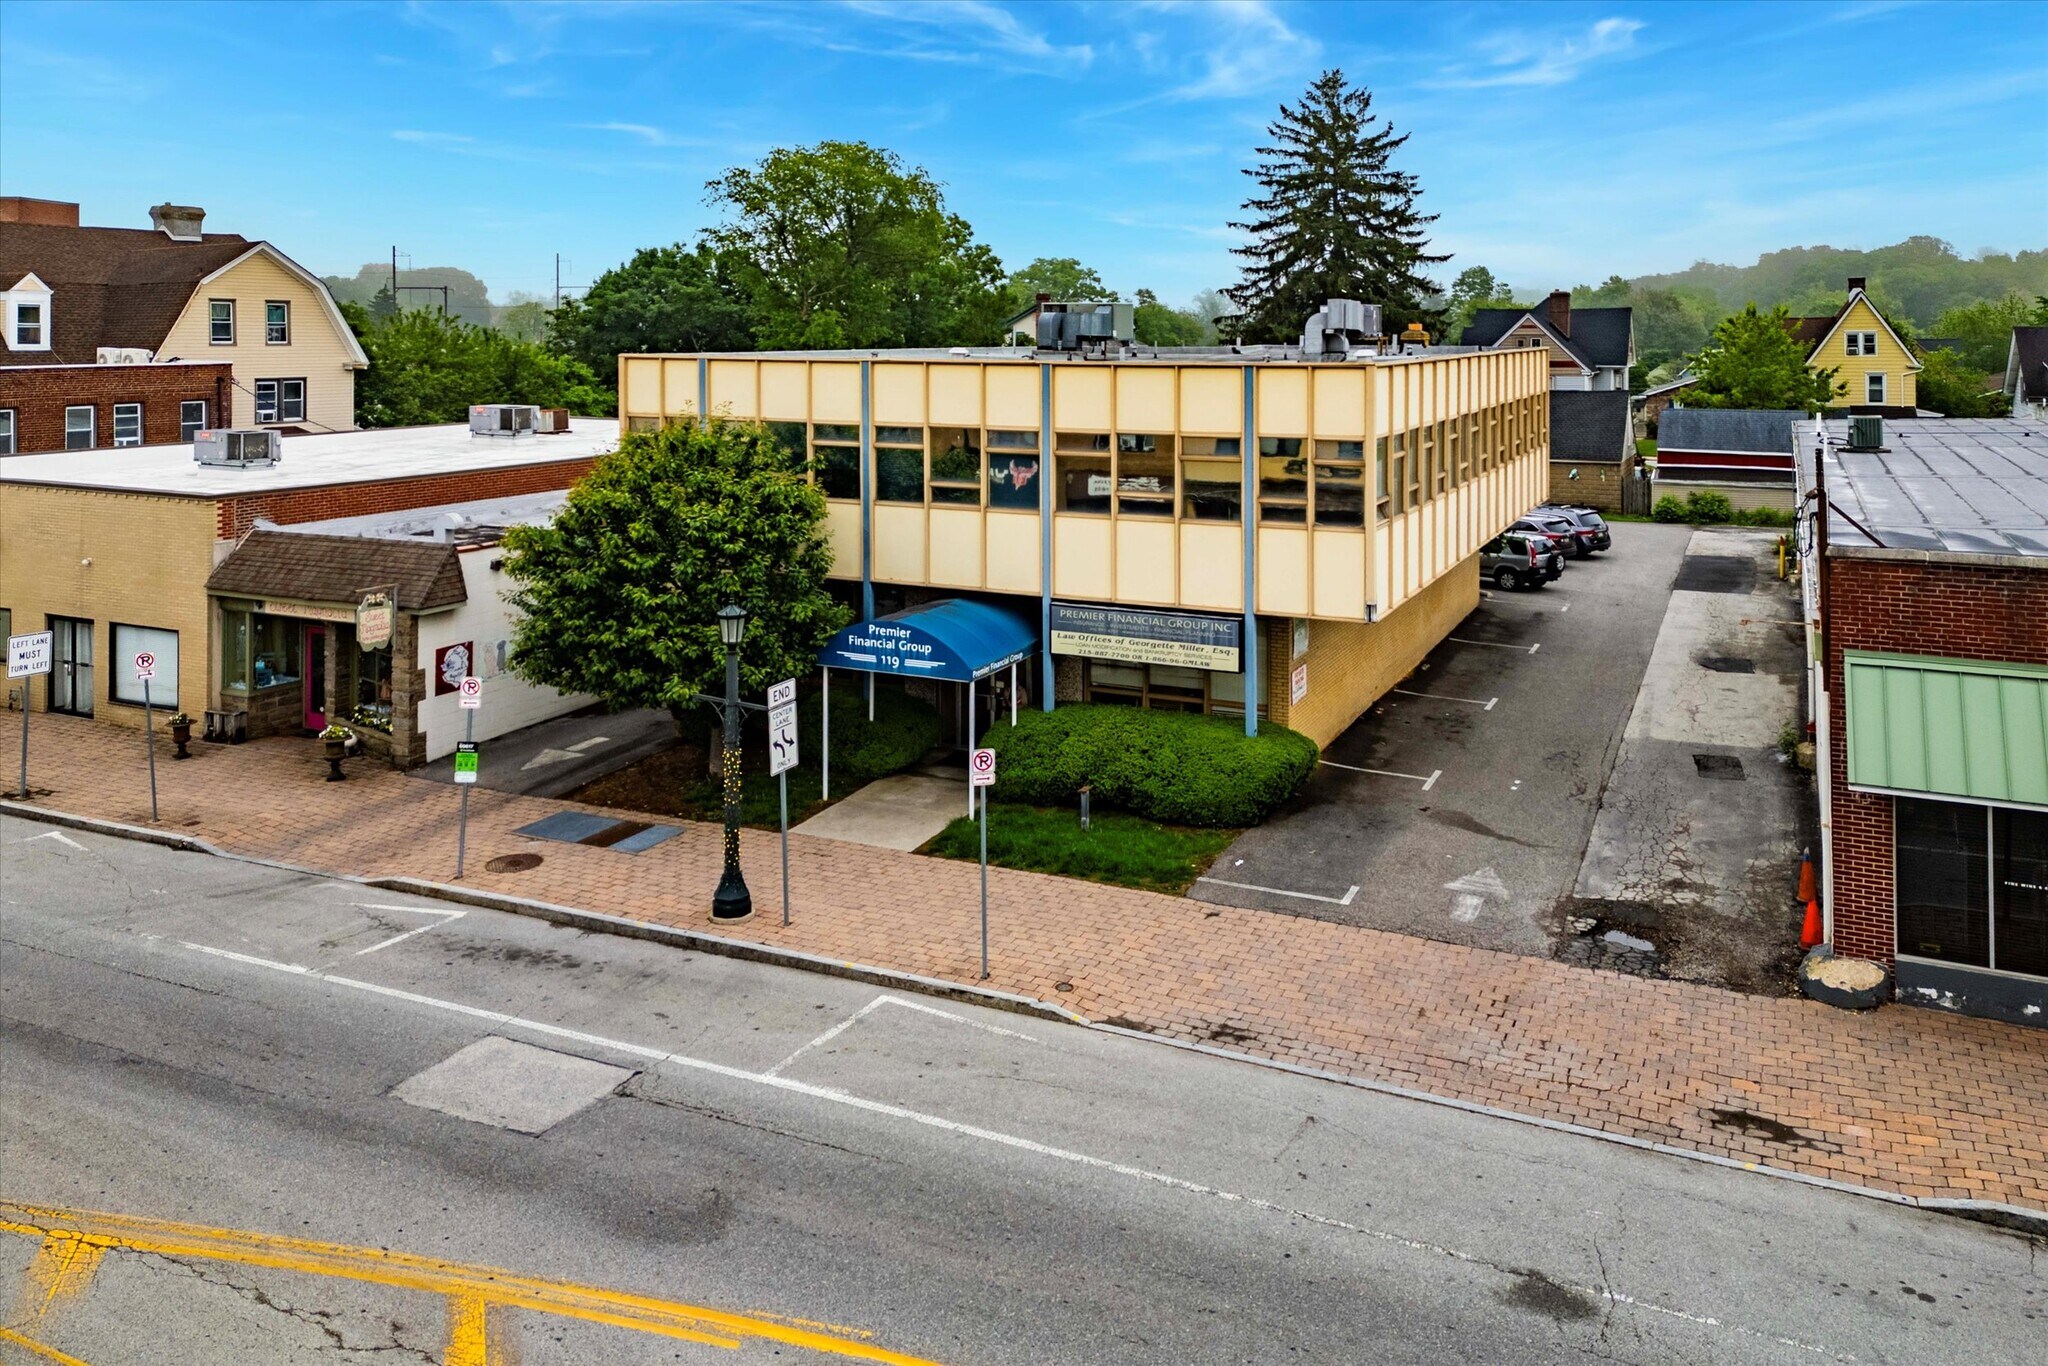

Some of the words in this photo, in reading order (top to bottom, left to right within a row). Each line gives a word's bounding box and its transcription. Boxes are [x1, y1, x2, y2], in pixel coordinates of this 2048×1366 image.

[1060, 609, 1106, 621] PREMIER
[1107, 613, 1165, 626] FINANCIAL
[1167, 619, 1208, 630] GROUP
[1211, 623, 1232, 633] INC
[1109, 623, 1149, 633] INVESTMENTS
[868, 624, 912, 638] Premier
[12, 640, 28, 649] LEFT
[32, 637, 49, 646] LANE
[848, 635, 896, 649] Financial
[898, 641, 932, 656] Group
[1057, 632, 1076, 640] Law
[1078, 634, 1112, 644] Offices
[1128, 639, 1175, 650] Georgette
[1212, 648, 1234, 657] Esq.
[1092, 643, 1132, 652] MODIFICATION
[1144, 649, 1183, 657] BANKRUPTCY
[19, 649, 41, 660] MUST
[11, 664, 28, 673] TURN
[32, 660, 48, 669] LEFT
[880, 655, 900, 669] 119
[972, 665, 991, 679] Premier
[990, 656, 1010, 671] Financial
[1009, 652, 1024, 663] Group
[773, 685, 791, 703] END
[772, 706, 793, 721] CENTER
[775, 716, 790, 727] LANE
[776, 758, 791, 769] ONLY
